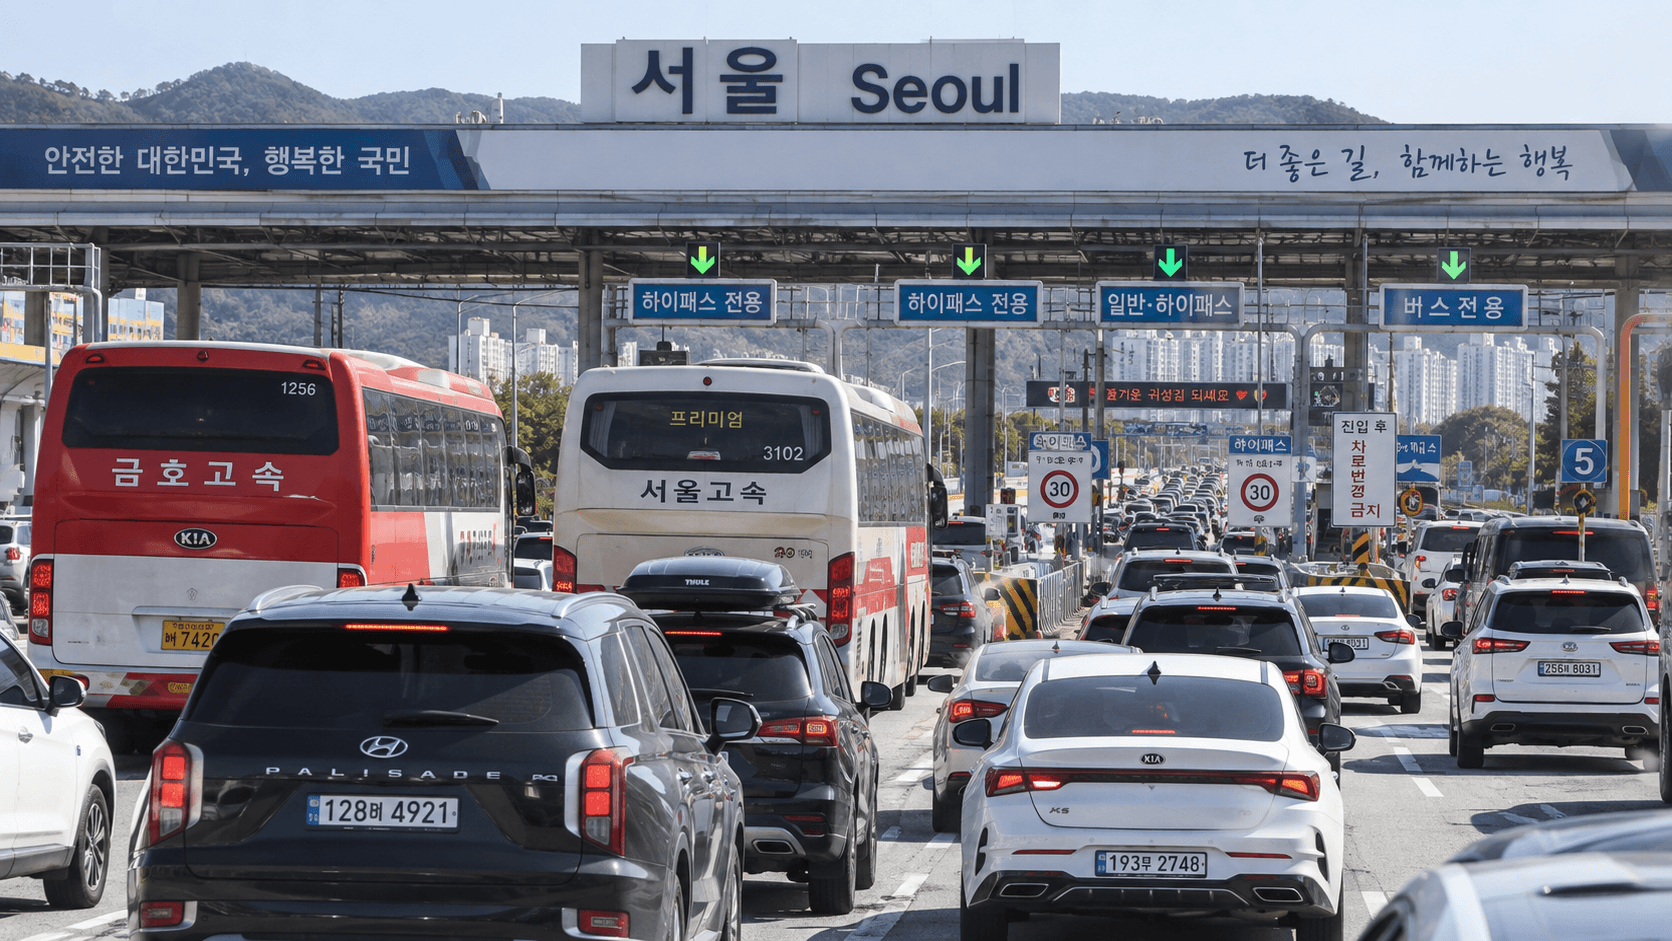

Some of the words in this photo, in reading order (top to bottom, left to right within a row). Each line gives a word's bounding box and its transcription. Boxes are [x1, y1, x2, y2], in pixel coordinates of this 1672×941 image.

[631, 47, 784, 115] 서울
[851, 63, 1020, 114] Seoul
[44, 146, 124, 175] 안전한
[137, 146, 250, 177] 대한민국,
[264, 146, 345, 175] 행복한
[357, 146, 410, 175] 국민
[1244, 150, 1266, 170] 더
[1279, 144, 1329, 183] 좋은
[1340, 145, 1379, 182] 길,
[1400, 144, 1506, 179] 함께하는
[1519, 144, 1573, 181] 행복
[642, 291, 716, 313] 하이패스
[724, 291, 763, 313] 전용
[908, 292, 982, 314] 하이패스
[991, 292, 1029, 315] 전용
[281, 381, 316, 396] 1256
[670, 410, 743, 428] 프리미엄
[1341, 420, 1368, 434] 진입
[1374, 420, 1387, 433] 후
[763, 445, 804, 461] 3102
[1574, 448, 1594, 475] 5
[640, 479, 767, 505] 서울고속
[1049, 481, 1070, 497] 30
[1250, 484, 1270, 500] 30
[180, 532, 211, 544] KIA
[1144, 755, 1161, 763] KIA
[265, 767, 500, 780] PALISADE
[391, 800, 448, 824] 4921
[1157, 855, 1200, 872] 2748
